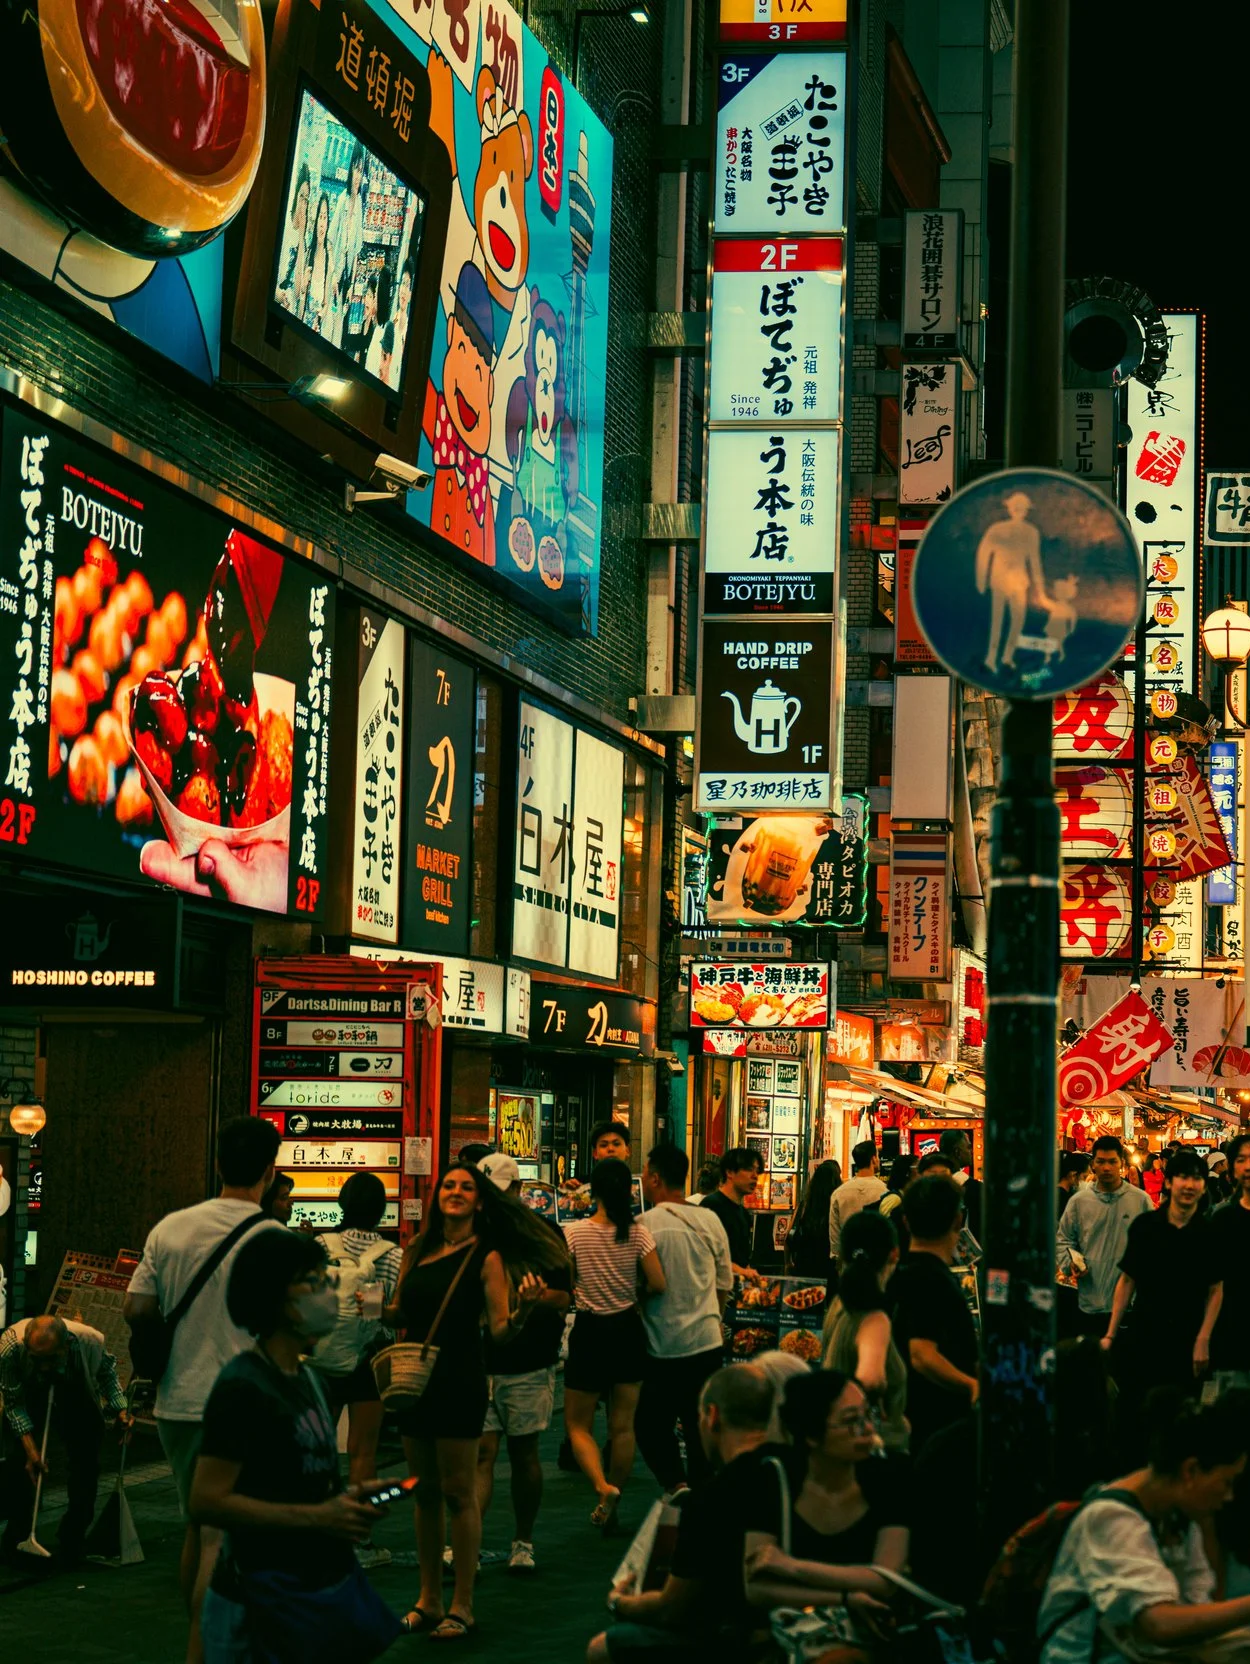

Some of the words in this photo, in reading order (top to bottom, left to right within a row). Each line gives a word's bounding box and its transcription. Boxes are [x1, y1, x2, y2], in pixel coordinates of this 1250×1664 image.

[336, 12, 415, 143] 道頓堀
[722, 63, 750, 82] 3F
[740, 127, 753, 182] 大阪名物
[803, 74, 838, 215] たこやき
[760, 245, 799, 270] 2F
[921, 213, 944, 332] 浪花囲碁サロン
[803, 345, 818, 374] 元祖
[731, 394, 761, 404] Since
[732, 407, 759, 416] 1946
[802, 381, 818, 410] 発祥
[902, 425, 951, 470] Leaf
[800, 439, 816, 527] 大阪伝統の味
[362, 616, 377, 649] 3F
[723, 642, 769, 655] HAND
[775, 642, 813, 655] DRIP
[737, 657, 799, 669] COFFEE
[436, 669, 451, 706] 7F
[520, 724, 536, 760] 4F
[801, 746, 823, 764] 1F
[381, 667, 400, 885] たこやき
[706, 777, 824, 803] 星乃珈琲店
[0, 798, 36, 845] 2F
[519, 776, 605, 899] 白木屋
[416, 844, 461, 880] MARKET
[295, 875, 320, 913] 2F
[422, 876, 454, 908] GRILL
[815, 861, 835, 918] 専門店
[12, 970, 88, 986] HOSHINO
[91, 970, 156, 986] COFFEE
[699, 966, 821, 986] 神戸牛と海鮮丼
[263, 991, 279, 1002] 9F
[288, 997, 368, 1013] Darts&Dining
[370, 999, 392, 1012] Bar
[543, 1000, 566, 1033] 7F
[267, 1028, 282, 1039] 8F
[293, 1145, 354, 1160] 白木屋
